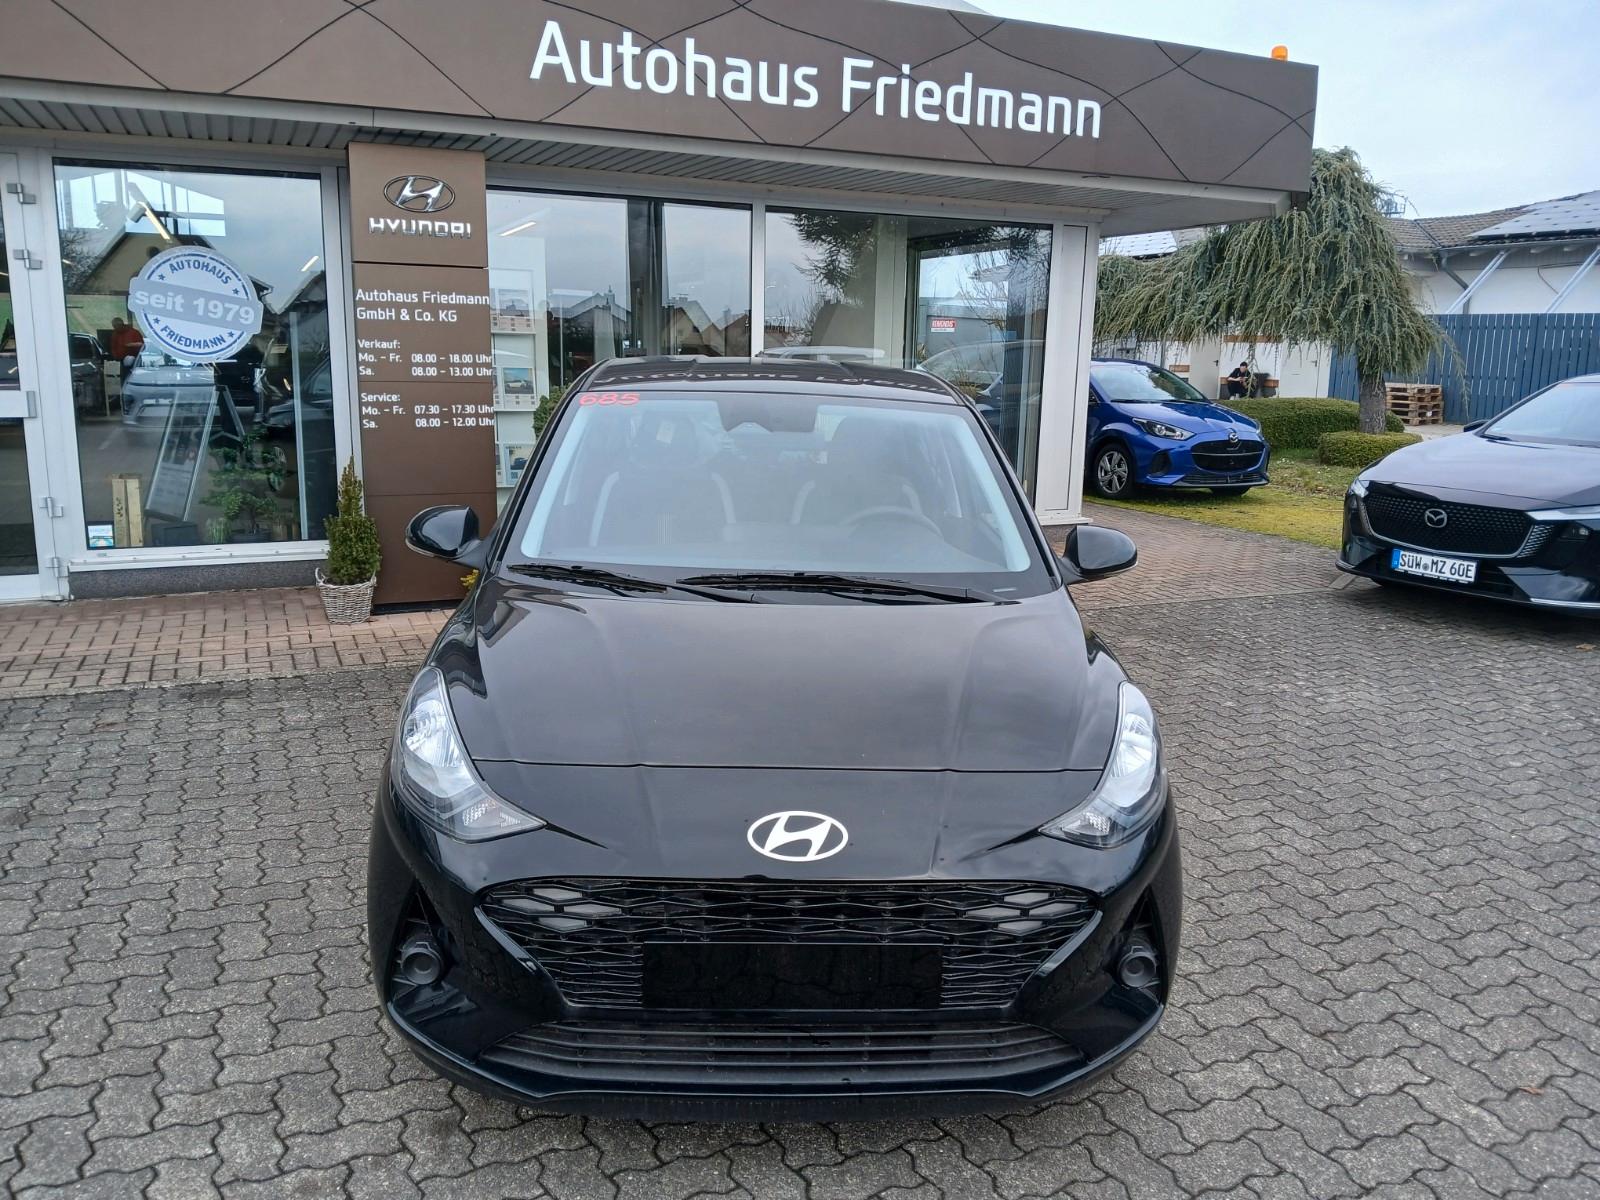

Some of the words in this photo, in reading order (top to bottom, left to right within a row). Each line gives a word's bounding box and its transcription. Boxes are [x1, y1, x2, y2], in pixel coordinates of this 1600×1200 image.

[529, 20, 819, 108] Autohaus
[841, 57, 1101, 139] Friedmann
[369, 217, 471, 238] HYUNDAI
[168, 260, 232, 285] AUTOHAUS
[355, 289, 418, 303] Autohaus
[422, 291, 489, 305] Friedmann
[134, 291, 184, 312] seit
[193, 299, 255, 324] 1979
[356, 307, 396, 321] GmbH
[400, 308, 410, 321] &
[414, 309, 435, 322] Co.
[439, 310, 457, 322] KG
[160, 325, 226, 349] FRIEDMANN
[357, 339, 401, 349] Verkauf:
[358, 353, 377, 362] Mo.
[389, 353, 402, 362] Fr.
[411, 354, 437, 363] 08.00
[449, 354, 473, 363] 18.00
[476, 354, 492, 363] Uhr
[359, 366, 375, 376] Sa.
[411, 367, 437, 376] 08.00
[449, 367, 473, 377] 13.00
[476, 367, 493, 376] Uhr
[361, 392, 401, 402] Service:
[579, 392, 640, 406] 685
[362, 406, 381, 415] Mo.
[393, 406, 406, 415] Fr.
[414, 405, 440, 414] 07.30
[451, 405, 475, 414] 17.30
[478, 404, 495, 414] Uhr
[363, 419, 378, 428] Sa.
[415, 418, 440, 427] 08.00
[452, 418, 476, 427] 12.00
[479, 417, 495, 427] Uhr
[1400, 553, 1422, 569] SÜW
[1431, 558, 1447, 574] MZ
[1449, 562, 1474, 579] 60E
